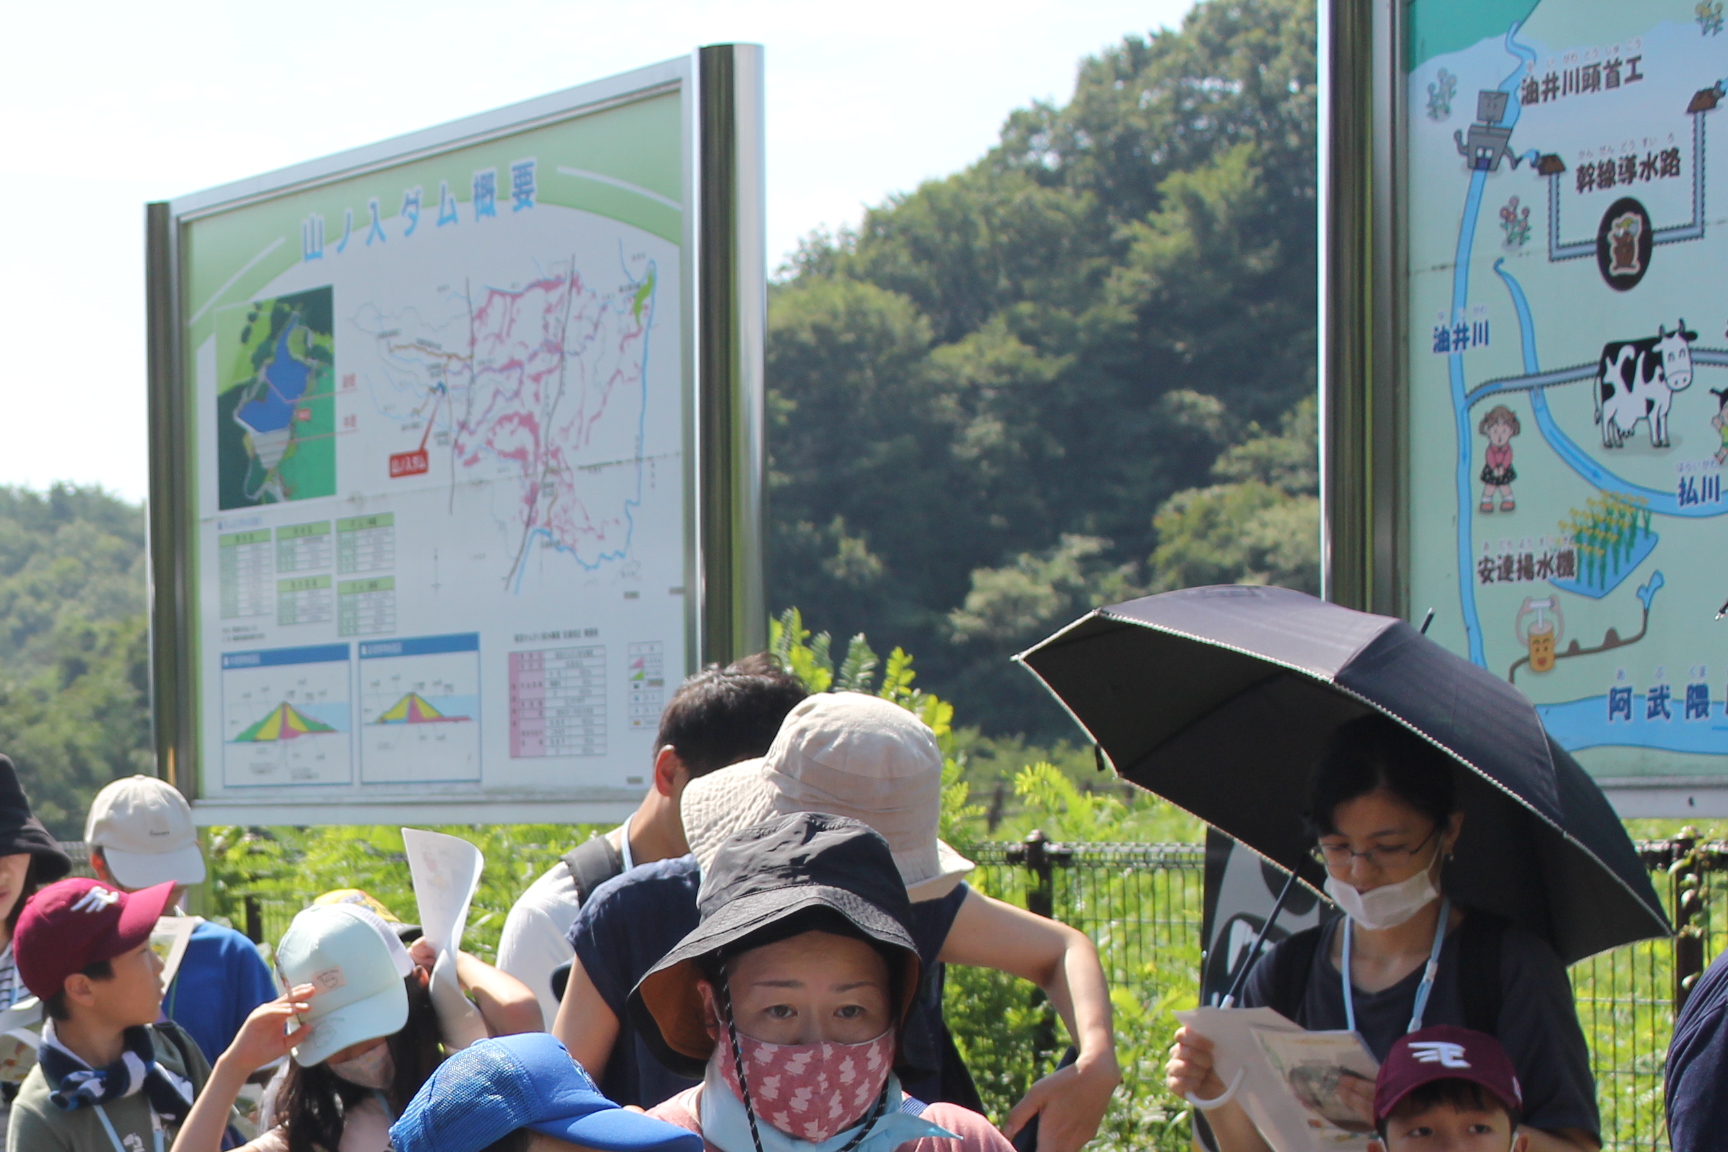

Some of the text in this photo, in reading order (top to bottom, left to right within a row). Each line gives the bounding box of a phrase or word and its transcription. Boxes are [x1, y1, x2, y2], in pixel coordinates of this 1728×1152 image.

[1521, 55, 1643, 106] 油井川頭首工
[1575, 147, 1682, 194] 幹線導水路
[303, 160, 536, 262] 山ノ入ダム概要
[1433, 320, 1489, 353] 油井川
[1678, 474, 1721, 507] 払川
[1609, 682, 1728, 722] 阿武隈
